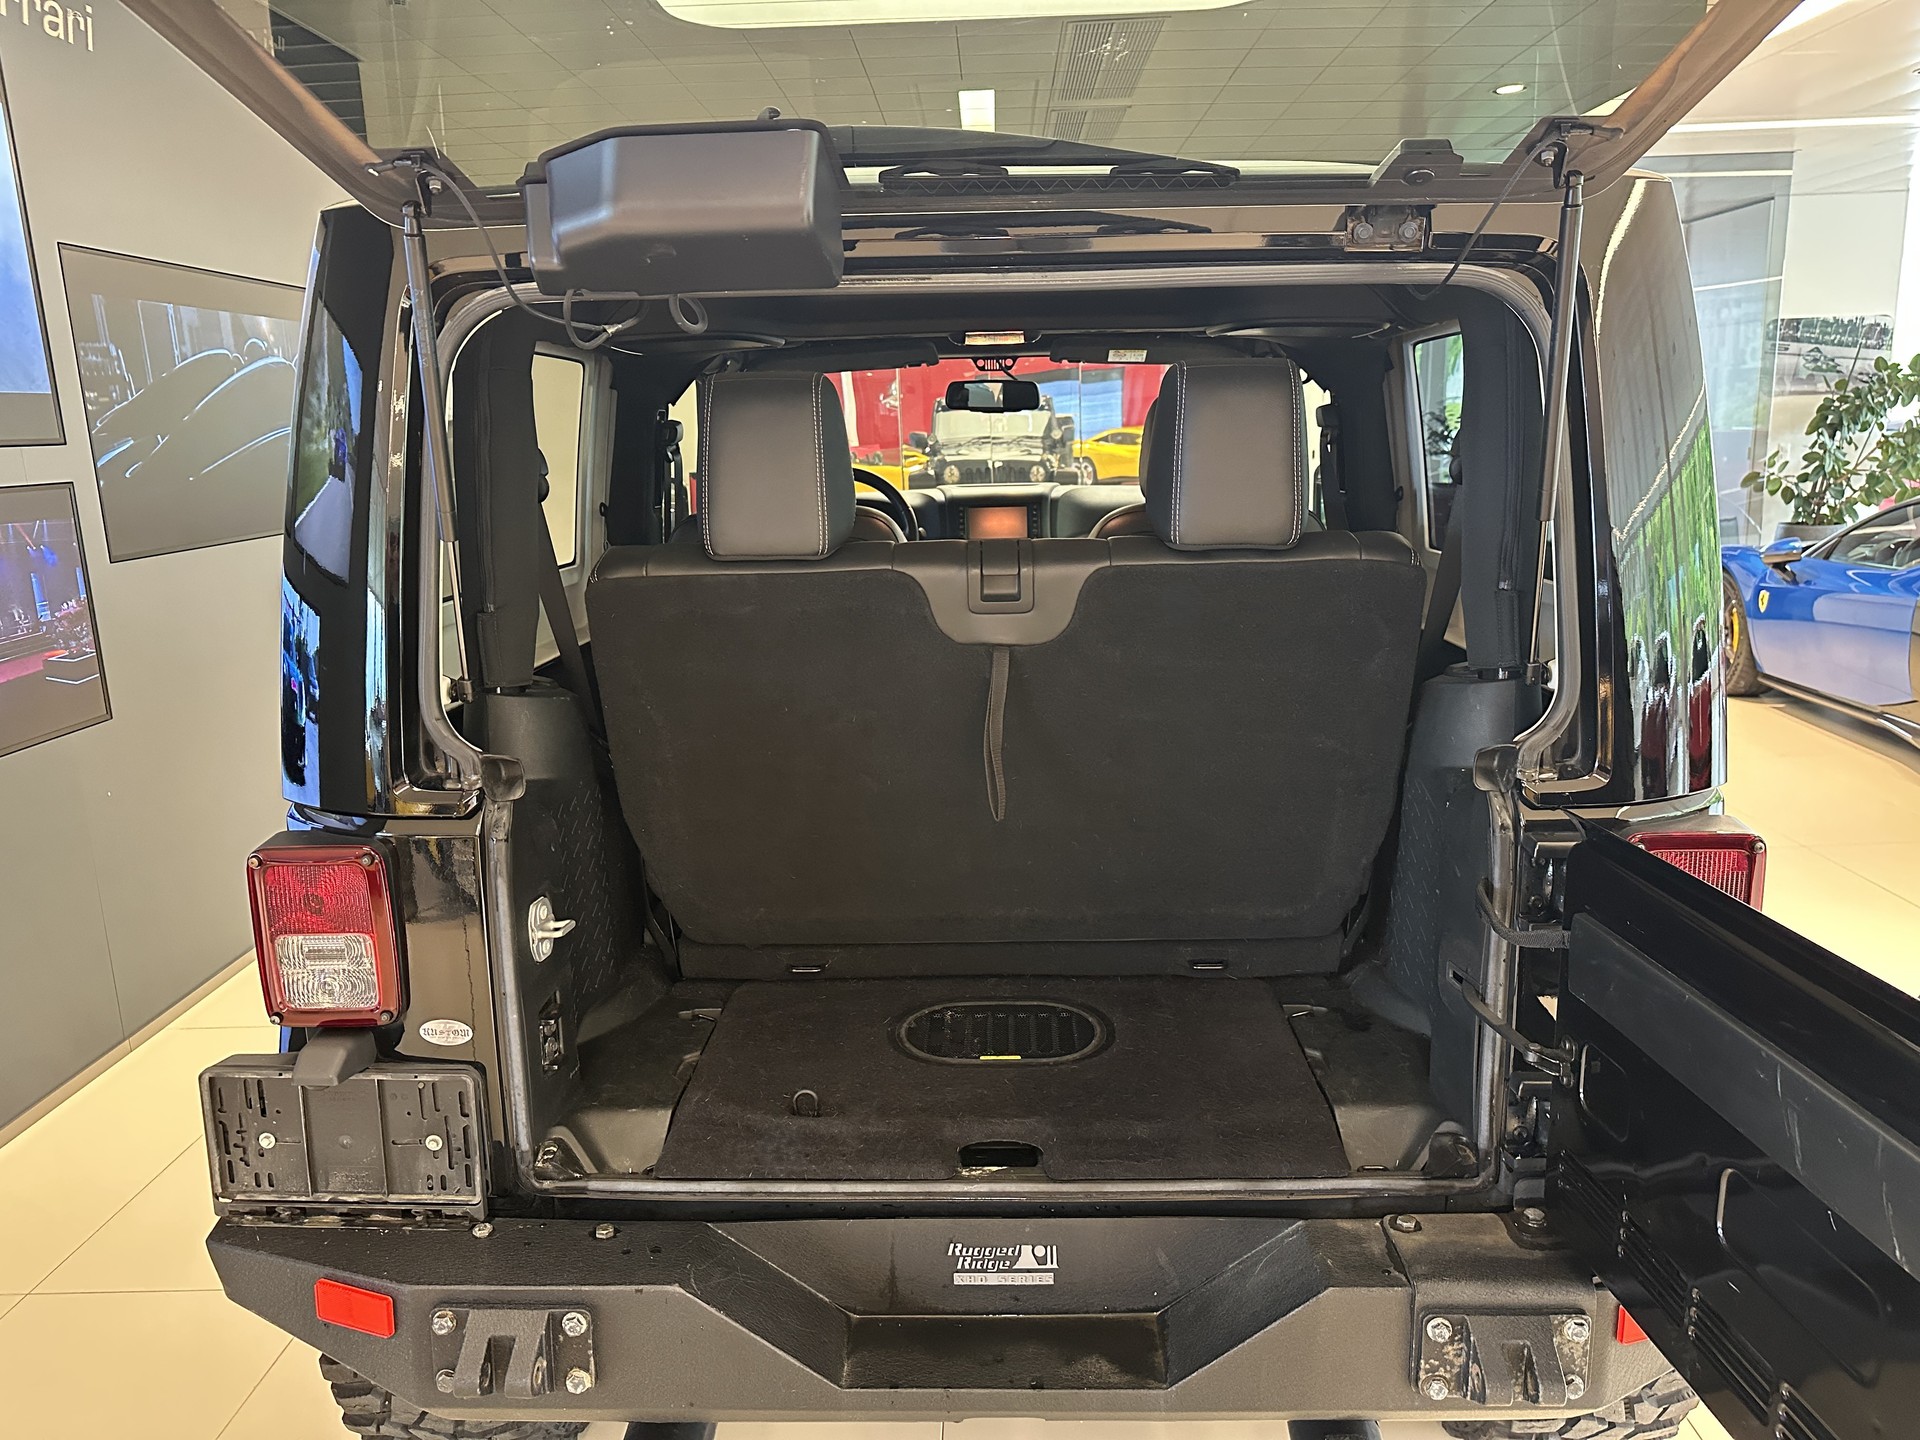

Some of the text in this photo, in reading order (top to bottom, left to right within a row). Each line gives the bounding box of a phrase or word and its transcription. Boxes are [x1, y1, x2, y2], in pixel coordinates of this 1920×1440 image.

[947, 1243, 1020, 1259] Rugged
[956, 1256, 1011, 1272] Ridge
[956, 1275, 1053, 1283] XHD SERIES
